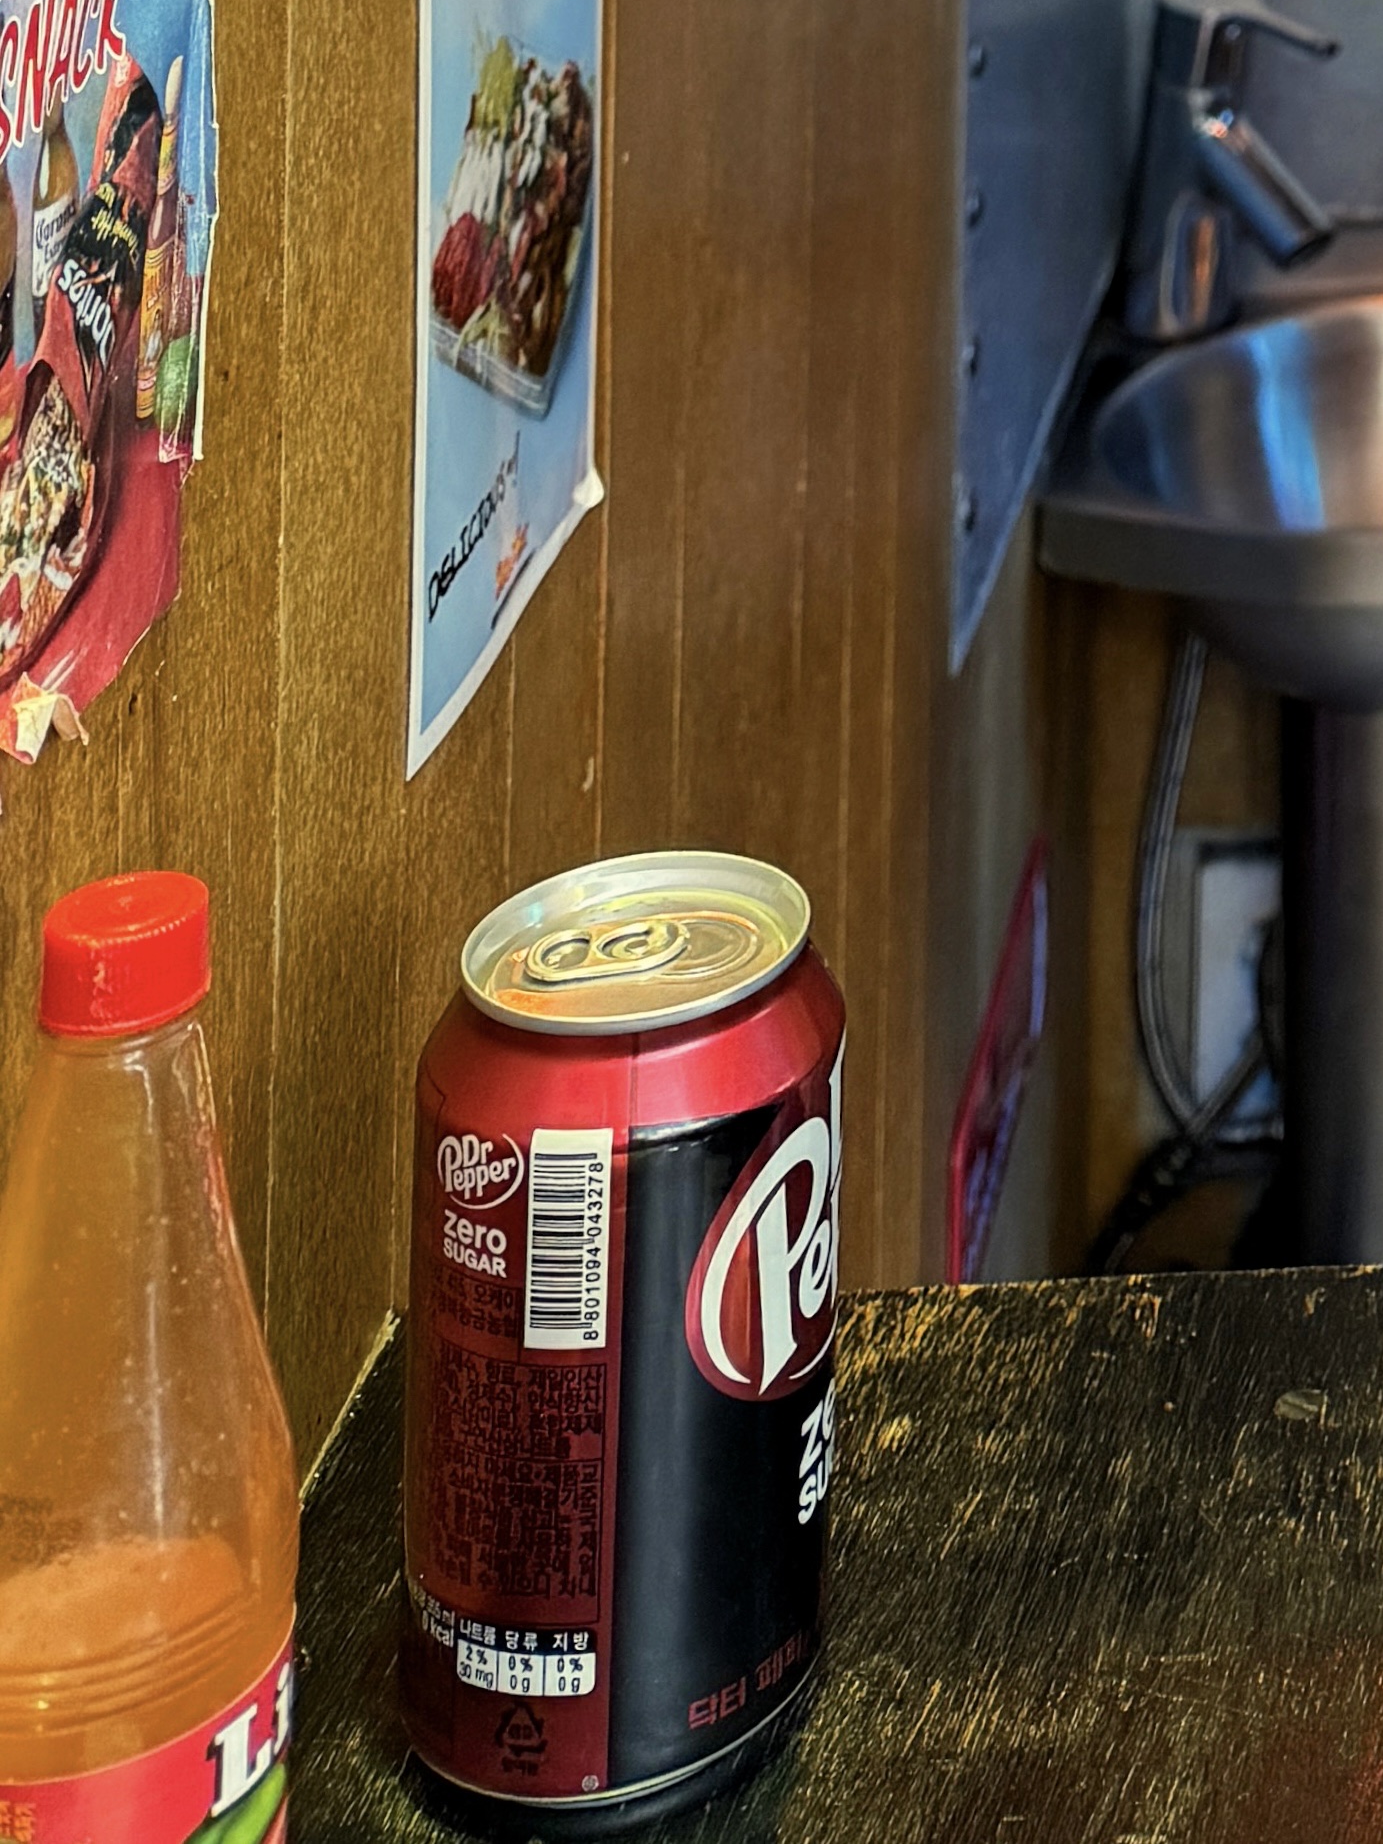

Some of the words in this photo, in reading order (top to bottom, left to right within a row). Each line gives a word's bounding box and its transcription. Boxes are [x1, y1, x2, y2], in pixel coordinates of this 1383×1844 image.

[437, 1135, 517, 1200] Pepper
[462, 1134, 493, 1167] Dr
[587, 1162, 604, 1238] 043278
[444, 1209, 507, 1255] zero
[700, 1116, 838, 1396] Pe
[443, 1237, 508, 1279] SUGAR
[584, 1247, 602, 1322] 801094
[430, 1616, 455, 1648] kcal
[459, 1618, 497, 1647] 나트륨
[688, 1674, 747, 1731] 닥터
